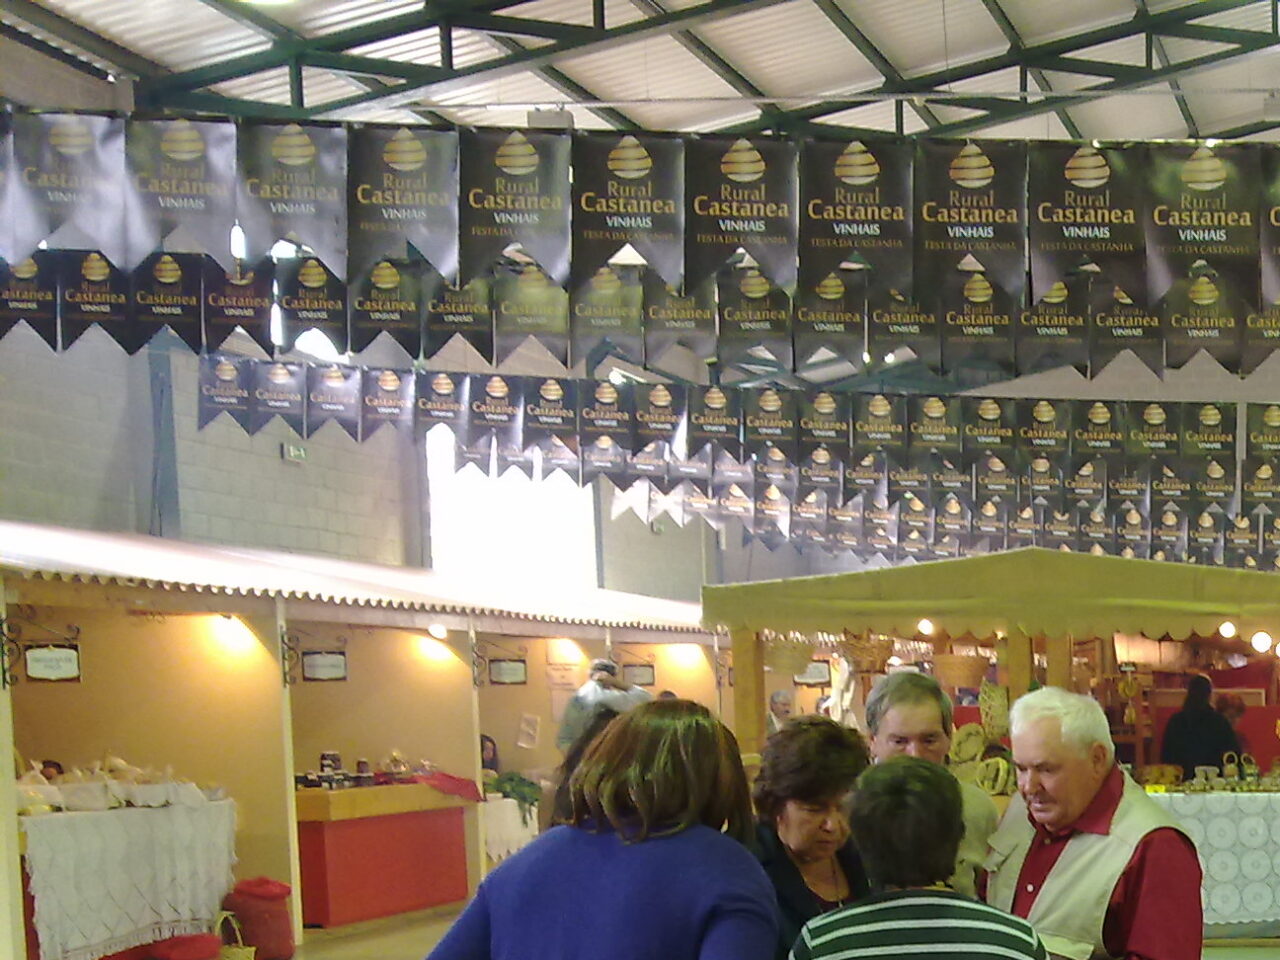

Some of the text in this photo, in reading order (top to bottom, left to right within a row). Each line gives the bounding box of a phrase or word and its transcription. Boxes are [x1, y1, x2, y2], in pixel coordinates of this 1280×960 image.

[383, 171, 427, 189] Rural
[495, 175, 539, 193] Rural
[607, 179, 652, 197] Rural
[245, 177, 339, 201] Castanea
[357, 183, 451, 206] Castanea
[720, 182, 765, 200] Rural
[834, 185, 880, 203] Rural
[949, 188, 994, 206] Rural
[1064, 188, 1110, 206] Rural
[158, 195, 205, 209] VINHAIS
[269, 200, 316, 214] VINHAIS
[469, 188, 563, 210] Castanea
[581, 191, 676, 214] Castanea
[694, 194, 790, 217] Castanea
[1180, 191, 1226, 209] Rural
[381, 206, 428, 220] VINHAIS
[807, 198, 905, 220] Castanea
[922, 201, 1018, 223] Castanea
[1037, 201, 1135, 223] Castanea
[1153, 205, 1252, 226] Castanea
[493, 211, 540, 224] VINHAIS
[605, 214, 652, 228] VINHAIS
[718, 218, 766, 231] VINHAIS
[832, 222, 880, 235] VINHAIS
[947, 224, 994, 237] VINHAIS
[1062, 225, 1111, 238] VINHAIS
[1178, 228, 1227, 241] VINHAIS
[65, 288, 125, 304] Castanea
[136, 290, 196, 306] Castanea
[282, 295, 342, 310] Castanea
[354, 296, 415, 312] Castanea
[428, 299, 488, 314] Castanea
[575, 303, 636, 317] Castanea
[649, 305, 710, 319] Castanea
[724, 307, 785, 320] Castanea
[798, 307, 860, 323] Castanea
[873, 309, 935, 324] Castanea
[946, 311, 1009, 325] Castanea
[1021, 311, 1083, 326] Castanea
[1096, 312, 1158, 327] Castanea
[1171, 313, 1235, 328] Castanea
